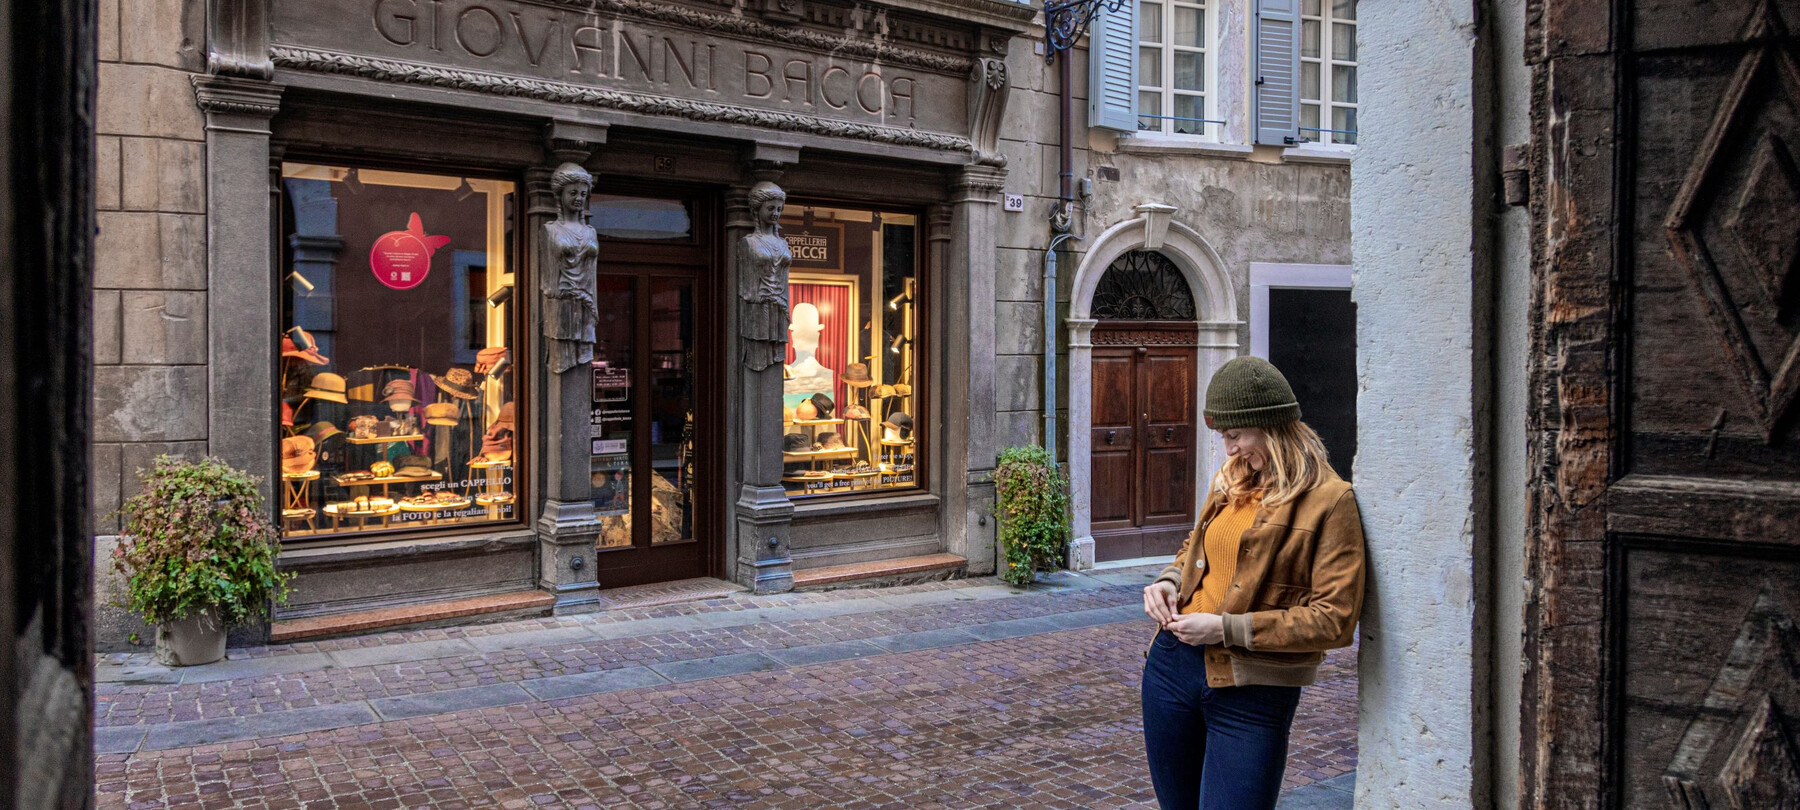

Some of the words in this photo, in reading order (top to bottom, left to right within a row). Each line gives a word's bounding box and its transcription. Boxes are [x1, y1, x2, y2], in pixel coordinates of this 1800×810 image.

[372, 0, 717, 93] GIOVANNI
[743, 50, 917, 120] BACCA
[1010, 198, 1022, 208] 39
[785, 236, 827, 246] CAPPELLERIA
[420, 480, 446, 492] scegli
[460, 477, 512, 488] CAPPELLO
[392, 514, 401, 522] la
[402, 511, 432, 520] FOTO
[443, 509, 452, 517] la
